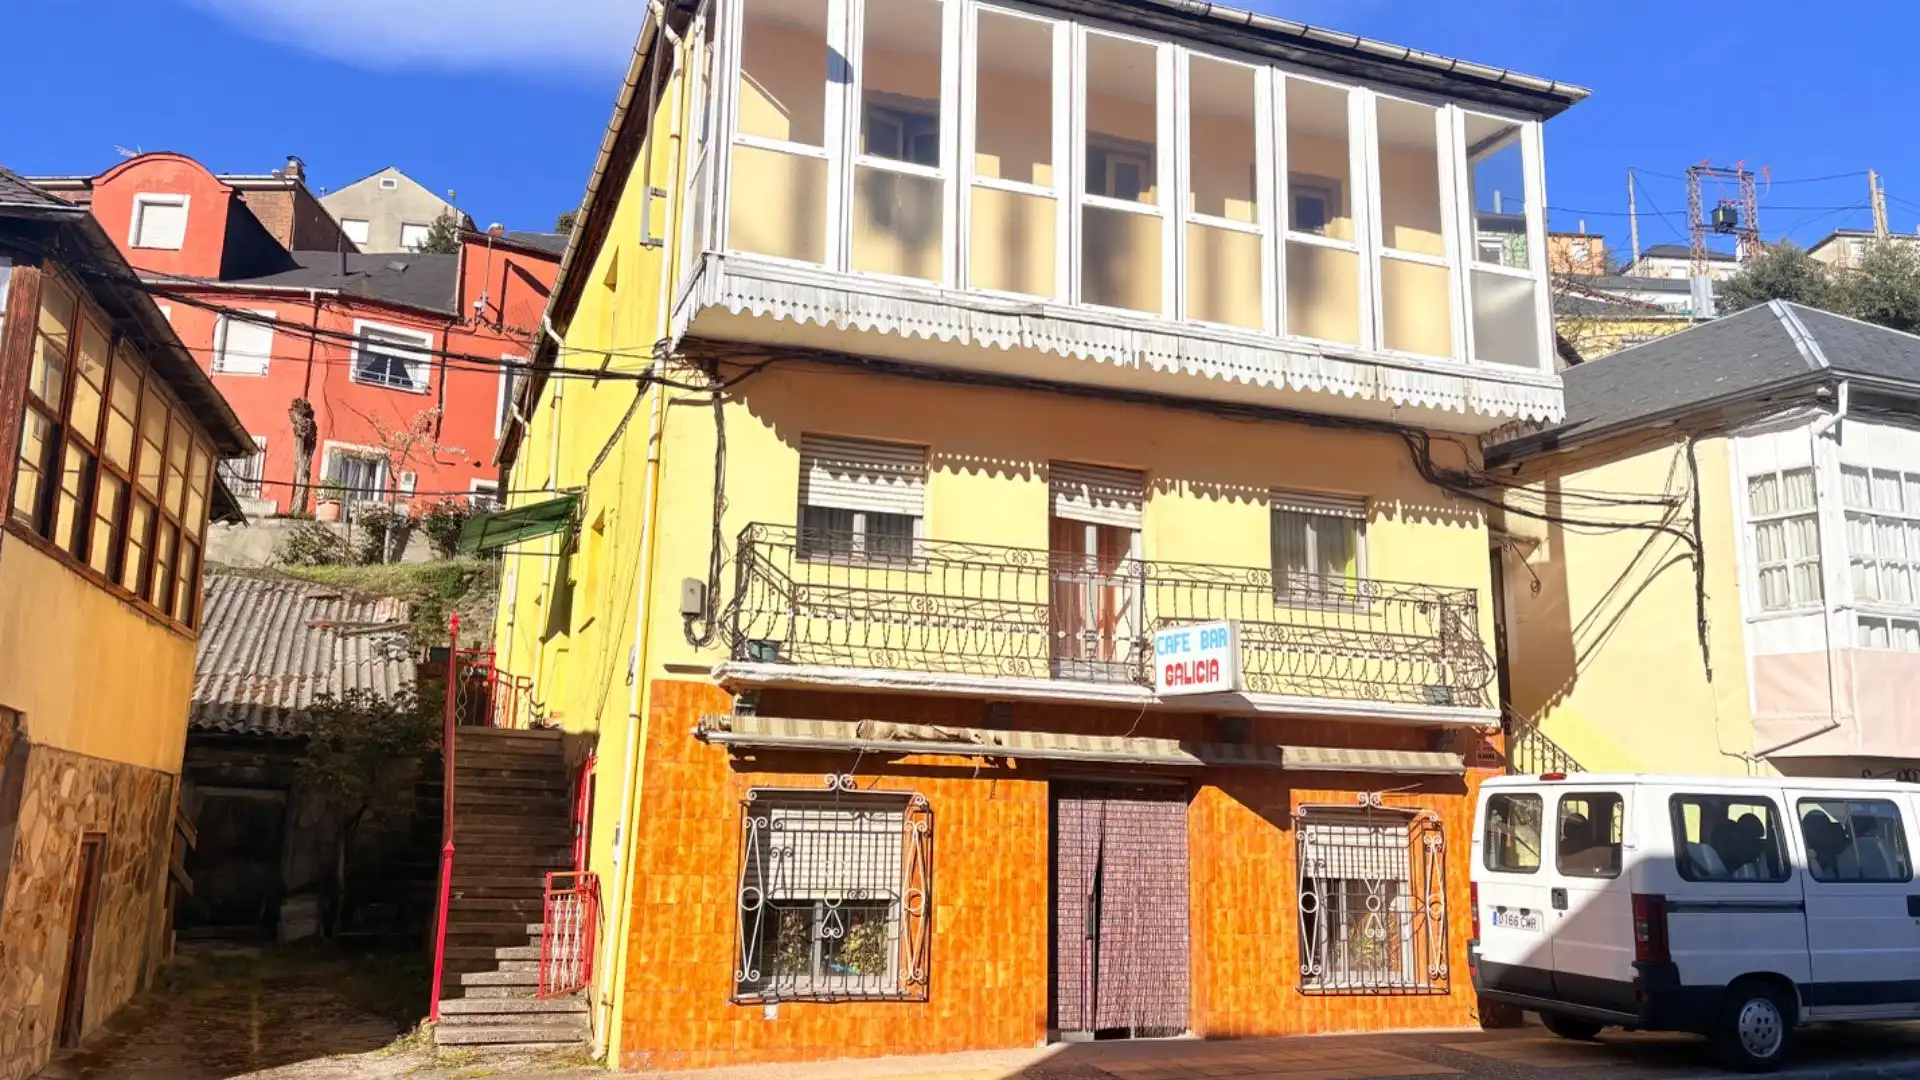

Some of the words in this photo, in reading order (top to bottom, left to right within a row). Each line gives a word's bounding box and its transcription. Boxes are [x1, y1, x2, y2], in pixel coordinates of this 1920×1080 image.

[1156, 633, 1191, 655] CAFE
[1200, 627, 1228, 650] BAR
[1165, 658, 1219, 687] GALICIA
